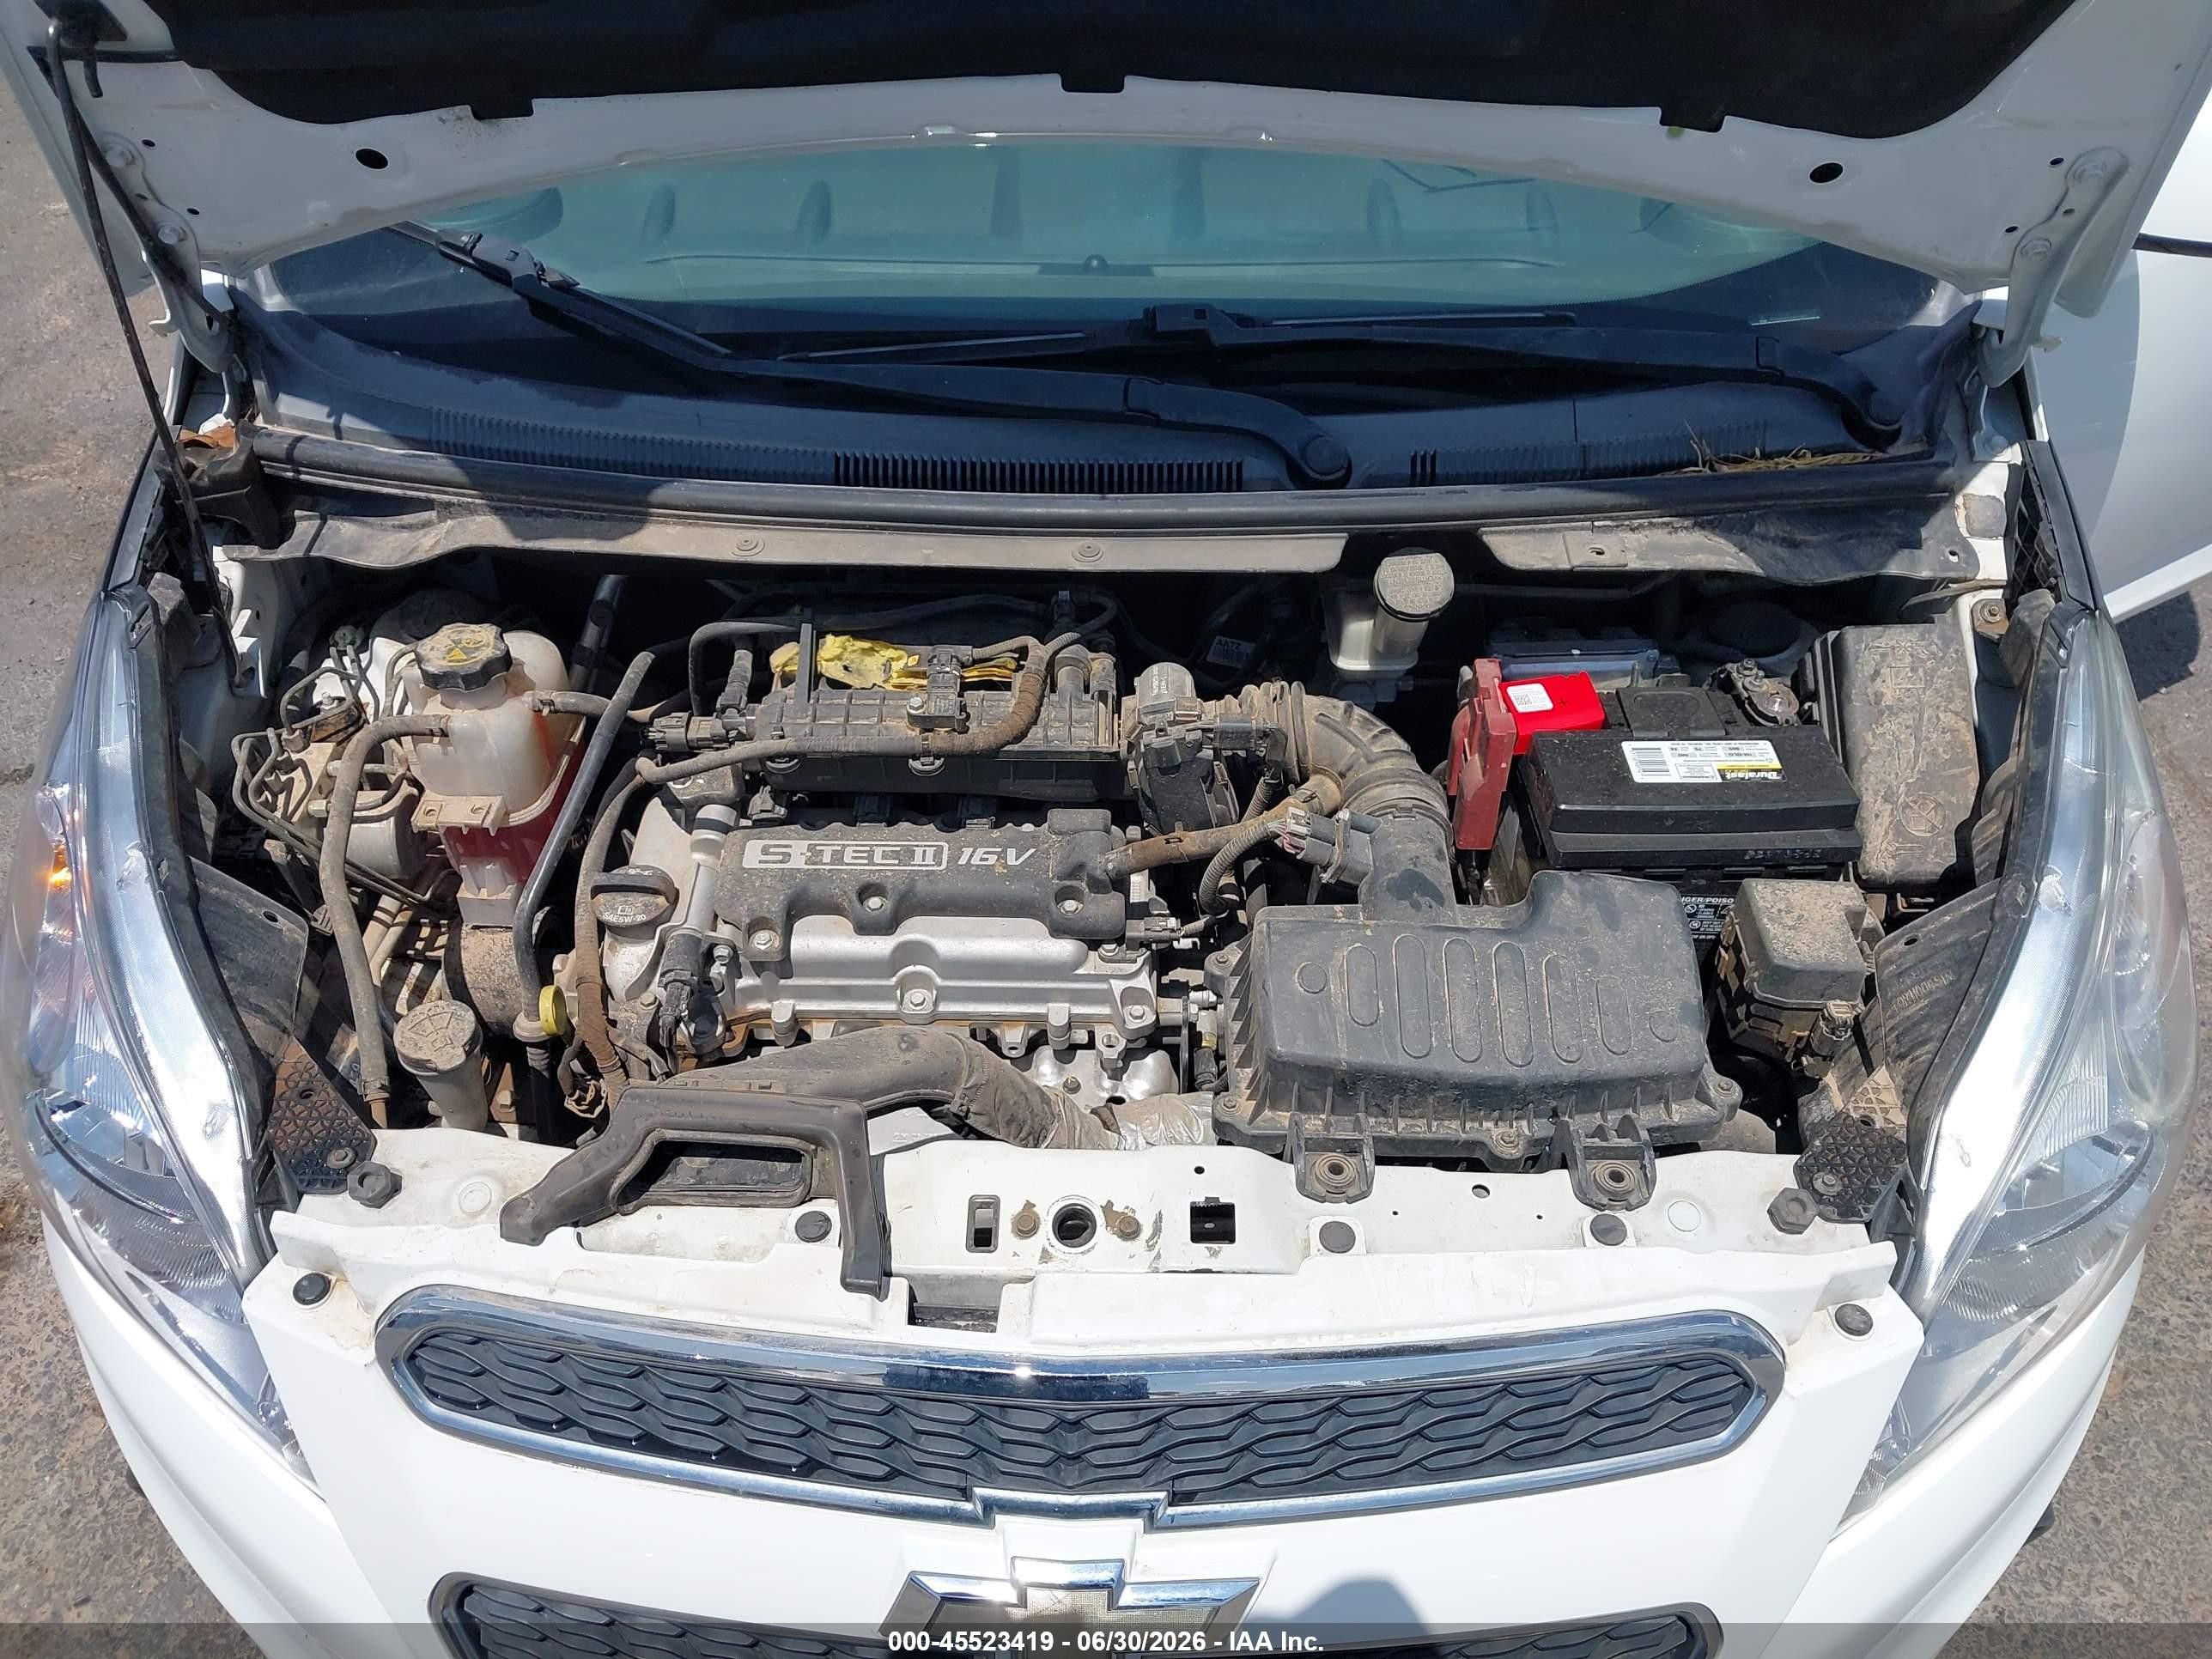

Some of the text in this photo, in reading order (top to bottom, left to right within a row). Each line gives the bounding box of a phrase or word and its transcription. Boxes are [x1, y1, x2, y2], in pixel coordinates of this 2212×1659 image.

[1725, 770, 1782, 780] Duralast
[910, 847, 937, 865] II
[957, 848, 1036, 866] 16V
